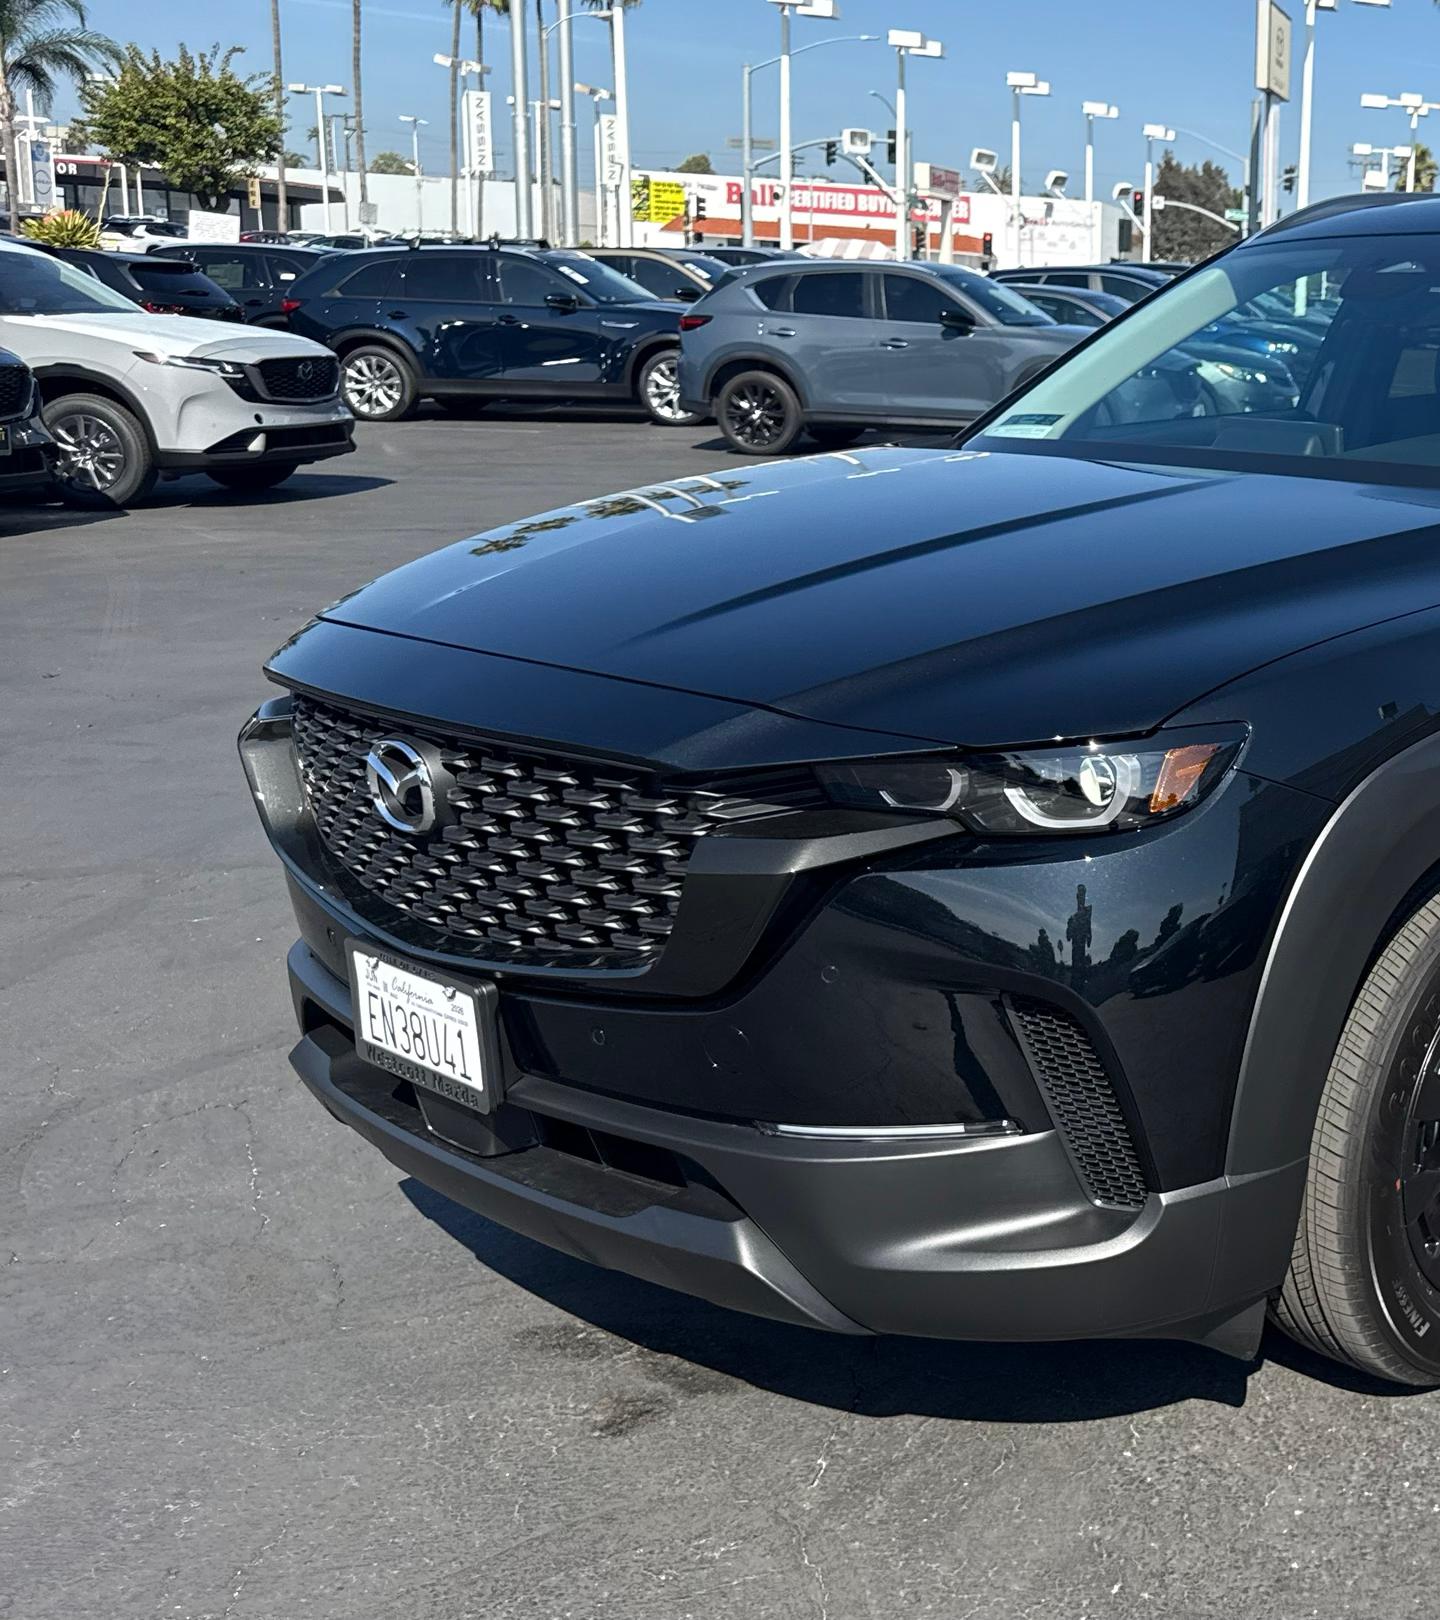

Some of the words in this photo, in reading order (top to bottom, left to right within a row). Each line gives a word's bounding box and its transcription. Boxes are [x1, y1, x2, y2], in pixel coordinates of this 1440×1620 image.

[475, 97, 487, 166] NISSAN
[606, 119, 617, 180] NISSAN
[392, 976, 434, 1005] California
[368, 990, 473, 1082] EN38U41
[432, 1073, 479, 1108] Mazda
